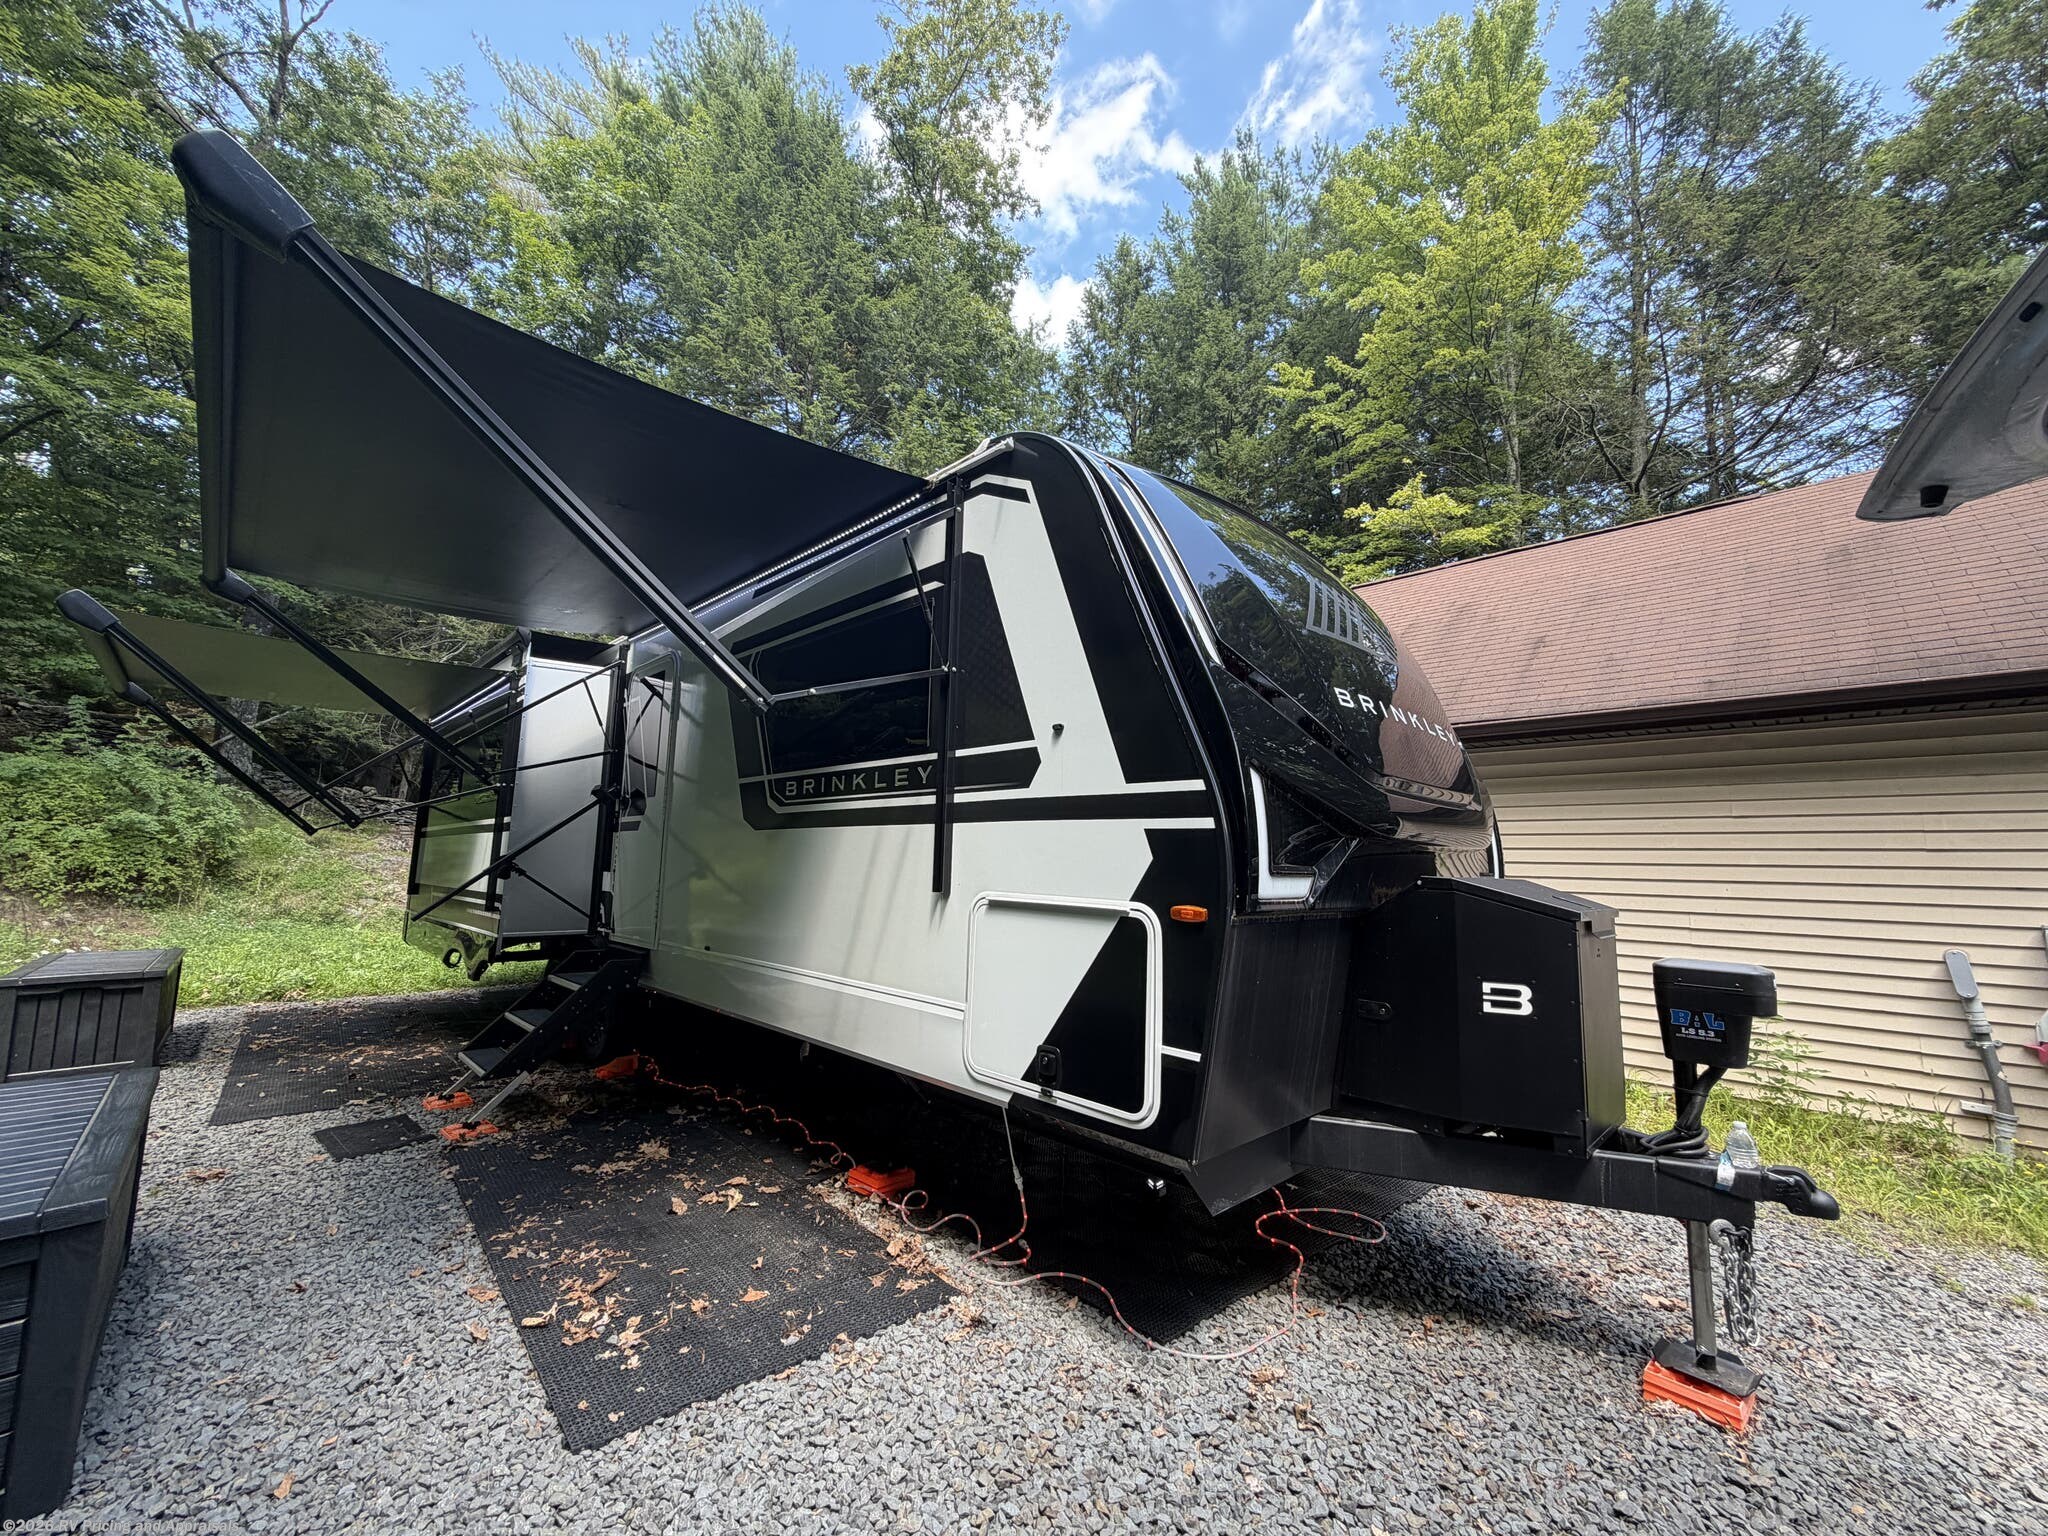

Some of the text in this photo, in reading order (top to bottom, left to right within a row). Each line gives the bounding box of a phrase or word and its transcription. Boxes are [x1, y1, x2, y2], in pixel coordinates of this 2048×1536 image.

[1333, 687, 1456, 747] BRINKLEY
[785, 765, 933, 796] BRINKLEY
[1482, 982, 1533, 1016] B
